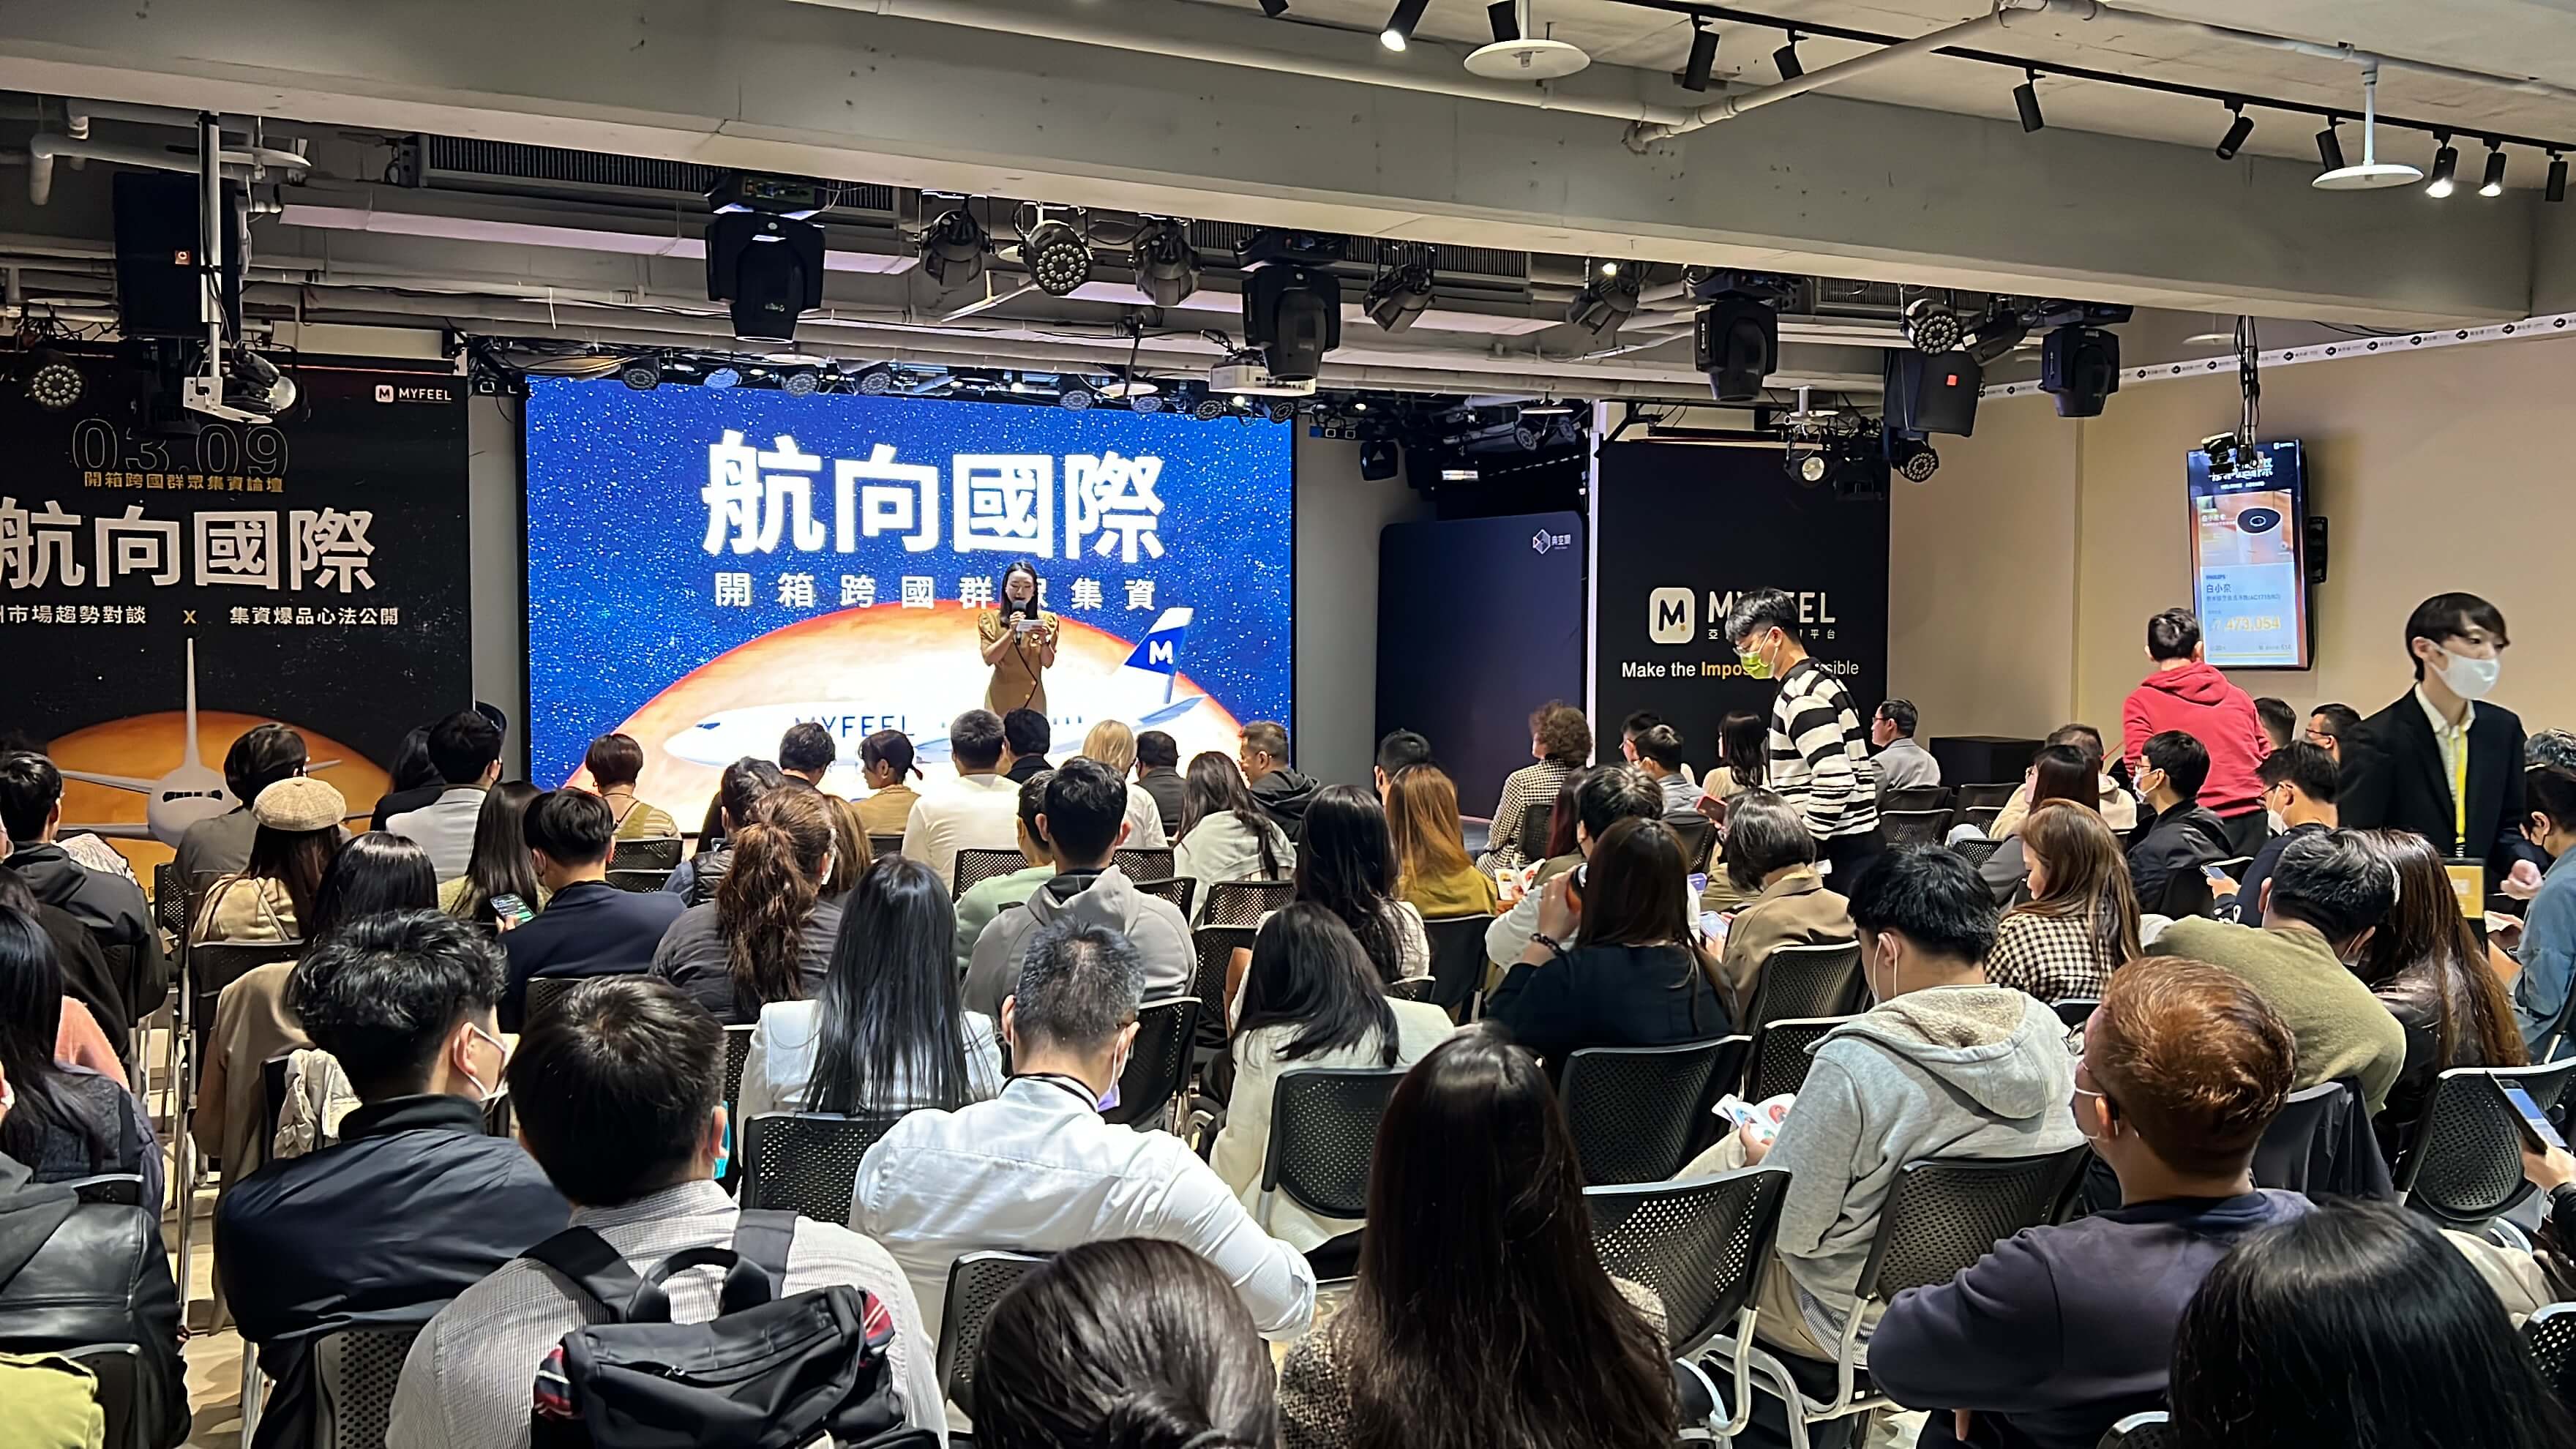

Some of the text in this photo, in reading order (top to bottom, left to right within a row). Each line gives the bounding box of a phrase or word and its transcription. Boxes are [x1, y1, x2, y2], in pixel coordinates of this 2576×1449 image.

[399, 387, 452, 400] MYFEEL
[84, 471, 285, 493] 開箱跨國群眾集資論壇
[701, 429, 1164, 564] 航向國際
[0, 497, 376, 594] 航向國際
[0, 605, 146, 624] 市場趨勢對談
[230, 606, 399, 625] 集資爆品心法公開
[1708, 591, 1836, 623] MEL
[1622, 662, 1666, 678] Make
[1671, 662, 1696, 676] the
